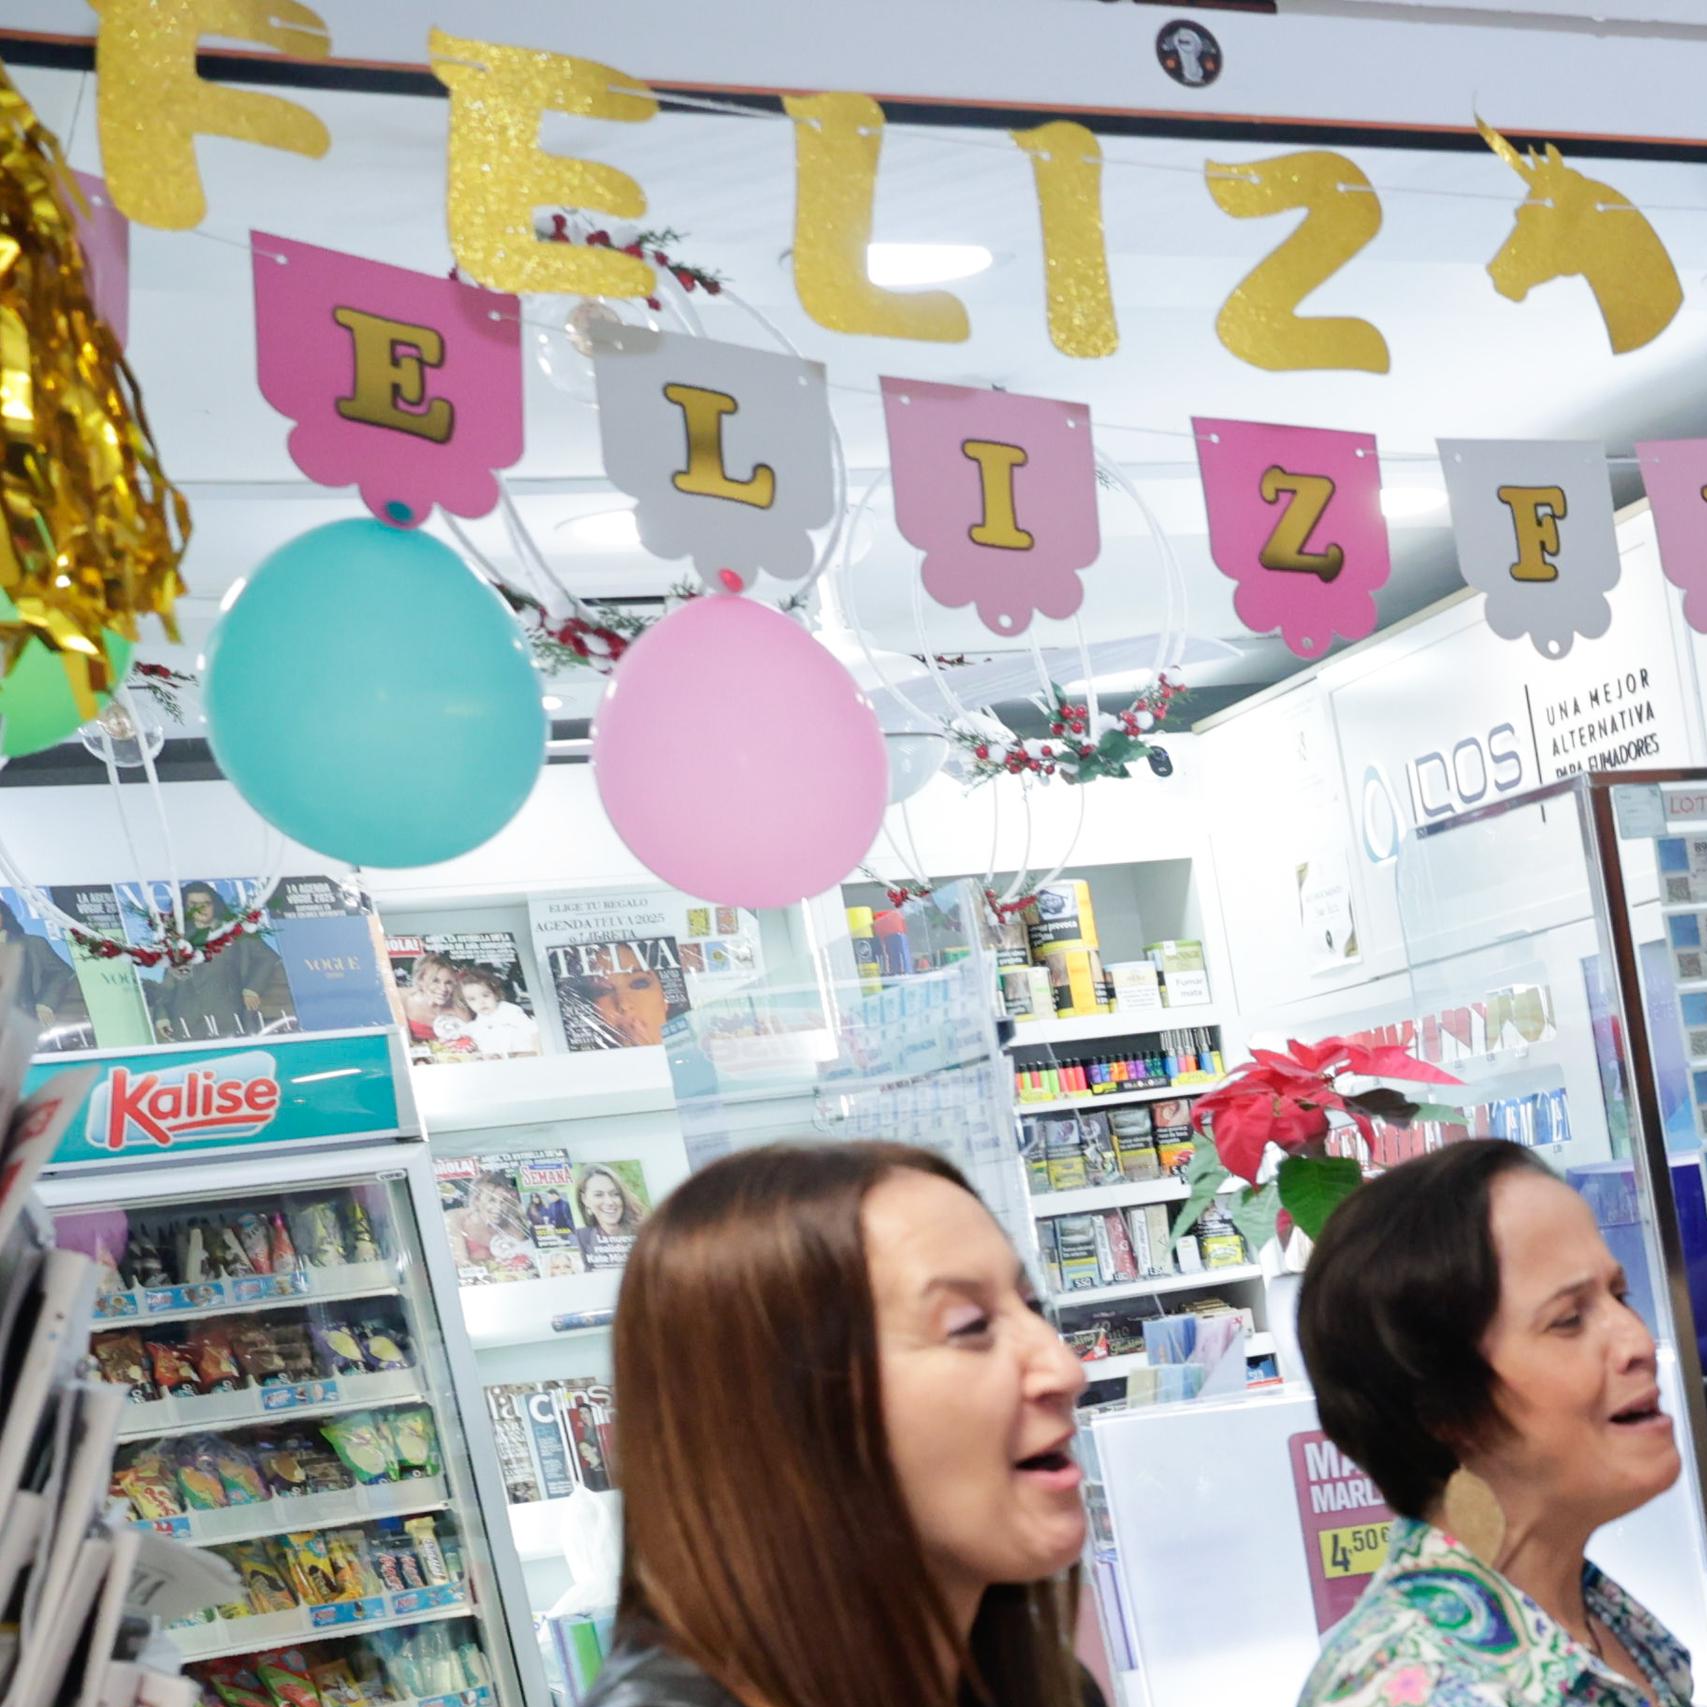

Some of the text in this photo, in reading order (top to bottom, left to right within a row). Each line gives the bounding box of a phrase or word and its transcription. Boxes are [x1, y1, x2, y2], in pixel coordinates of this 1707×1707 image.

[84, 0, 1390, 374] FELIZ
[1546, 667, 1651, 726] UNA MEJOR
[1552, 700, 1657, 758] ALTERNATIVA
[1588, 732, 1661, 773] FUMADORES
[549, 937, 680, 979] TELVA
[106, 1066, 280, 1150] Kalise
[519, 1165, 574, 1186] SEMANA
[1310, 1477, 1386, 1514] MARL
